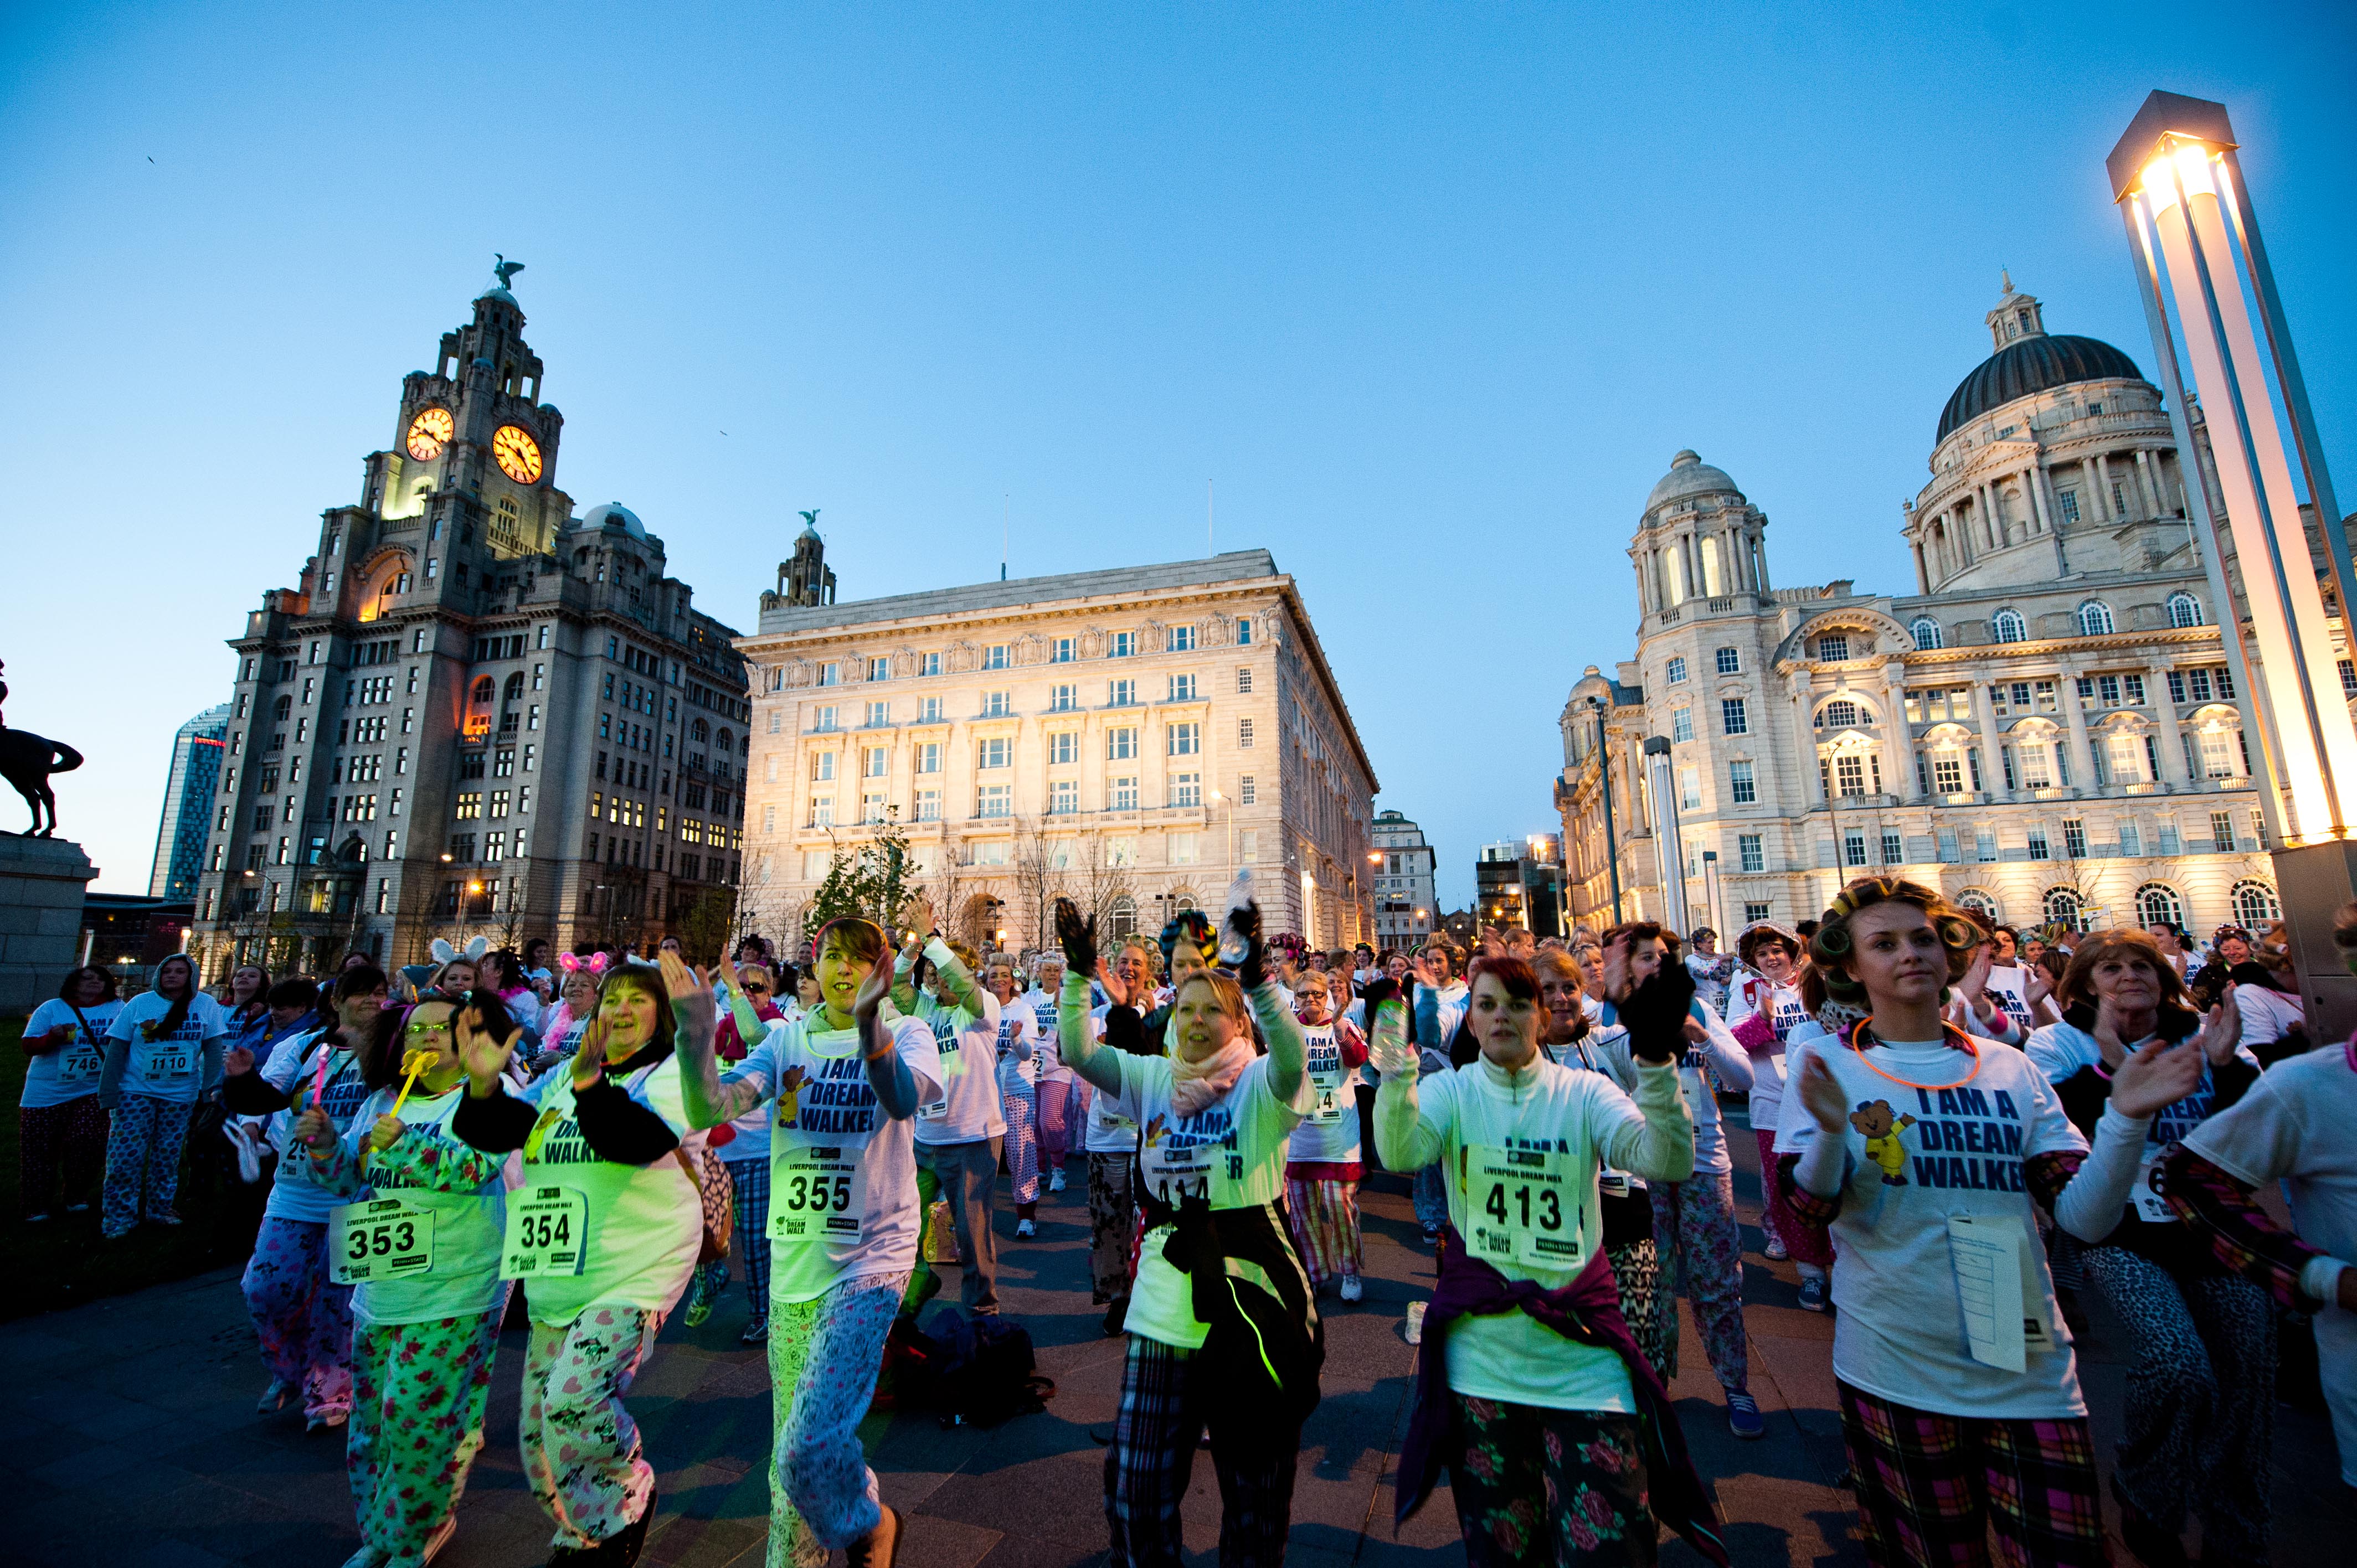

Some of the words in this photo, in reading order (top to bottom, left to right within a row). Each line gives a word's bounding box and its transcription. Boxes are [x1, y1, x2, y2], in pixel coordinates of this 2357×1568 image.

[1777, 1007, 1780, 1015] I
[1783, 1003, 1801, 1014] AM
[90, 1018, 106, 1027] AM
[1311, 1037, 1326, 1047] AM
[1329, 1038, 1334, 1046] A
[67, 1058, 98, 1071] 746
[152, 1057, 186, 1069] 1110
[820, 1058, 830, 1079] I
[829, 1058, 863, 1080] AM
[320, 1085, 370, 1100] REAM
[809, 1081, 877, 1107] DREAM
[1916, 1087, 1932, 1115] I
[1938, 1087, 1992, 1117] AM
[1994, 1090, 2021, 1120] A
[1191, 1112, 1223, 1135] AM
[1917, 1120, 2024, 1156] DREAM
[545, 1141, 605, 1164] WALK
[1484, 1165, 1519, 1179] LIVERPOOL
[1520, 1170, 1545, 1181] DREAM
[1912, 1156, 2026, 1193] WALKE
[788, 1176, 851, 1211] 355
[1486, 1182, 1562, 1231] 413
[347, 1215, 379, 1227] LIVERPOOL
[379, 1213, 401, 1221] DREAM
[521, 1213, 570, 1248] 354
[348, 1221, 415, 1260] 353
